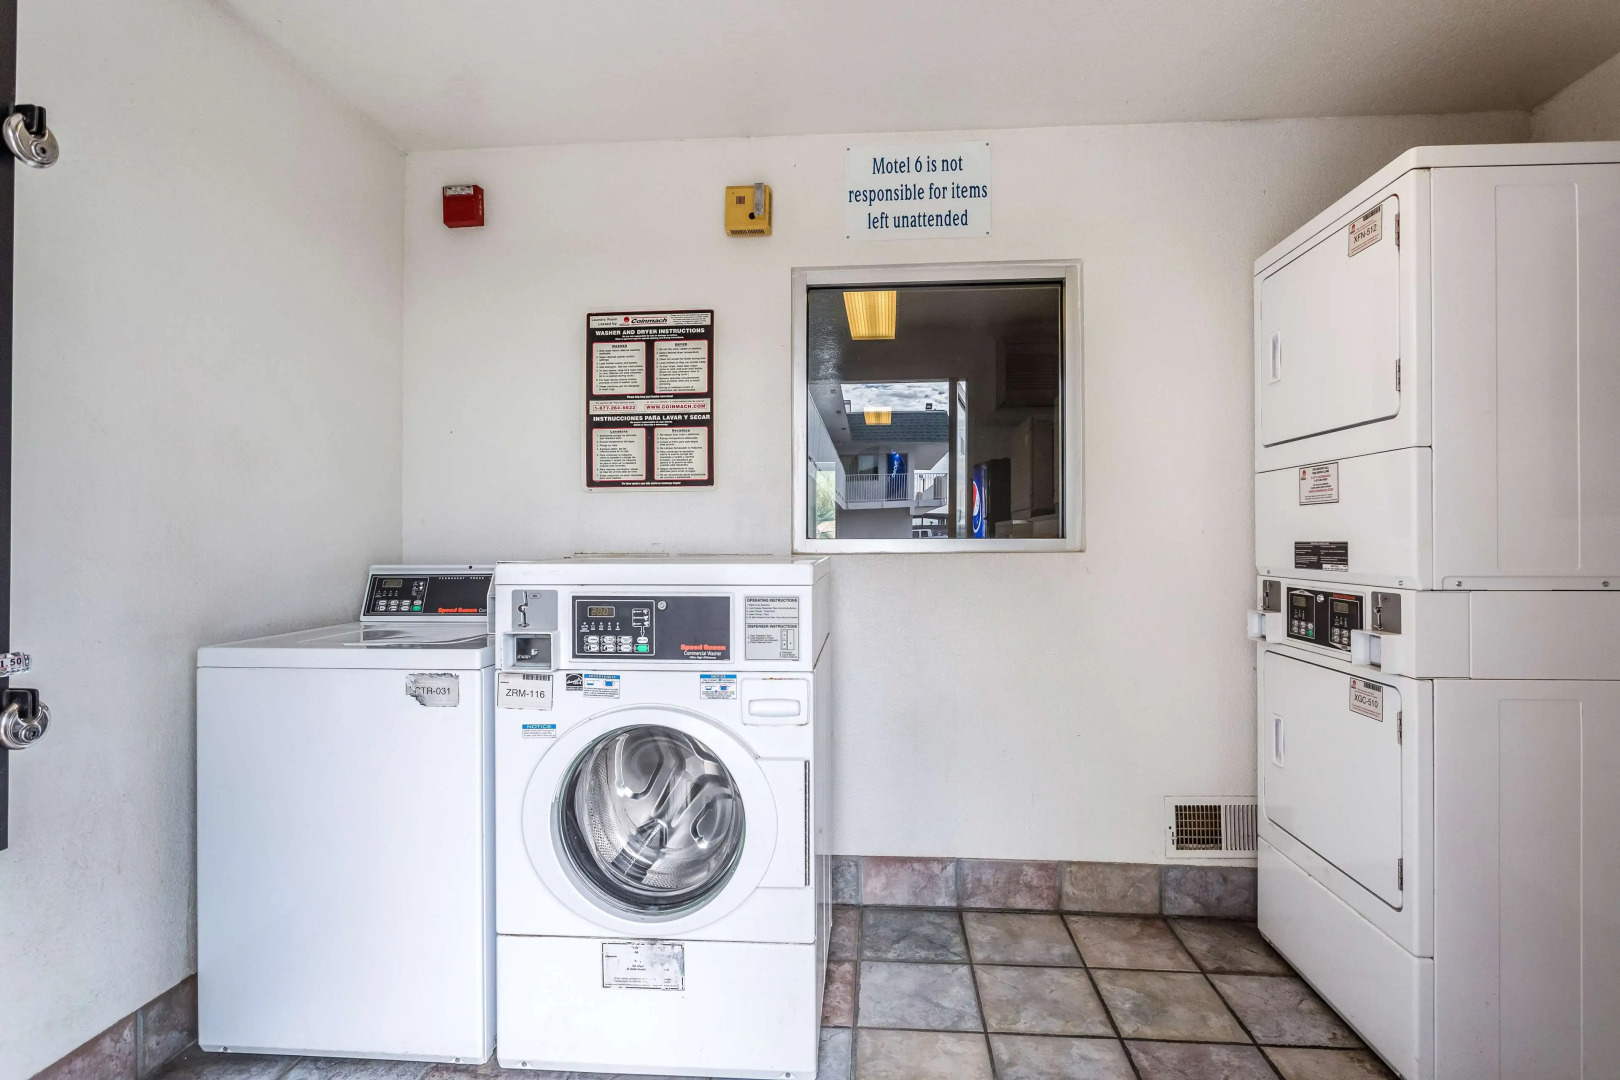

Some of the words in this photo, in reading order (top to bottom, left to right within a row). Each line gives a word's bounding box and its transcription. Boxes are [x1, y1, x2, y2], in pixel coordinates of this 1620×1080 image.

[872, 157, 910, 174] Motel
[915, 156, 923, 173] 6
[927, 156, 937, 172] is
[941, 156, 963, 172] not
[848, 184, 925, 206] responsible
[929, 183, 947, 199] for
[951, 182, 988, 198] items
[868, 212, 889, 229] left
[893, 209, 968, 228] unattended
[1354, 224, 1377, 244] XFN-512
[681, 644, 703, 652] Speed
[506, 689, 546, 699] ZRM-116
